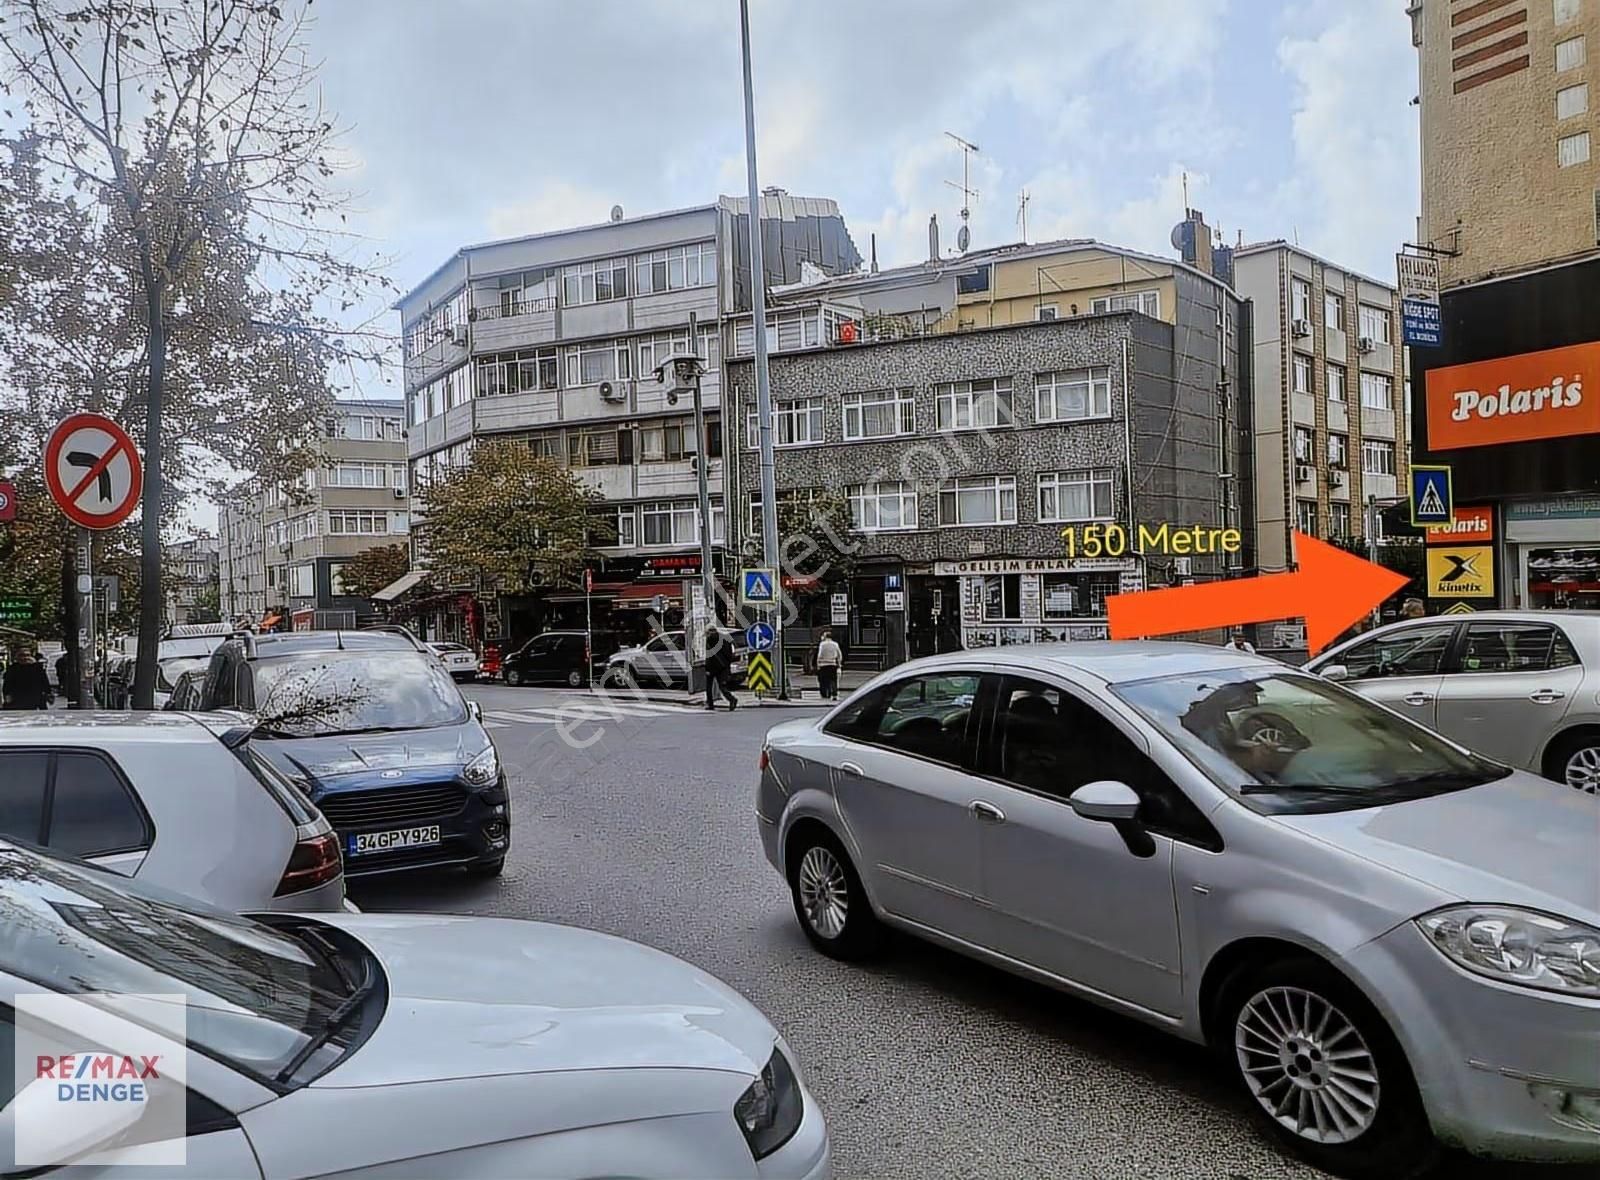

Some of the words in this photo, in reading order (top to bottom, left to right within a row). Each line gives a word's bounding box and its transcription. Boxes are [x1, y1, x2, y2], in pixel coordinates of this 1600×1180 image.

[1451, 373, 1584, 422] Polaris
[958, 560, 1021, 573] GELİŞİM
[1025, 559, 1077, 570] EMLAK
[1437, 582, 1483, 593] kinetix
